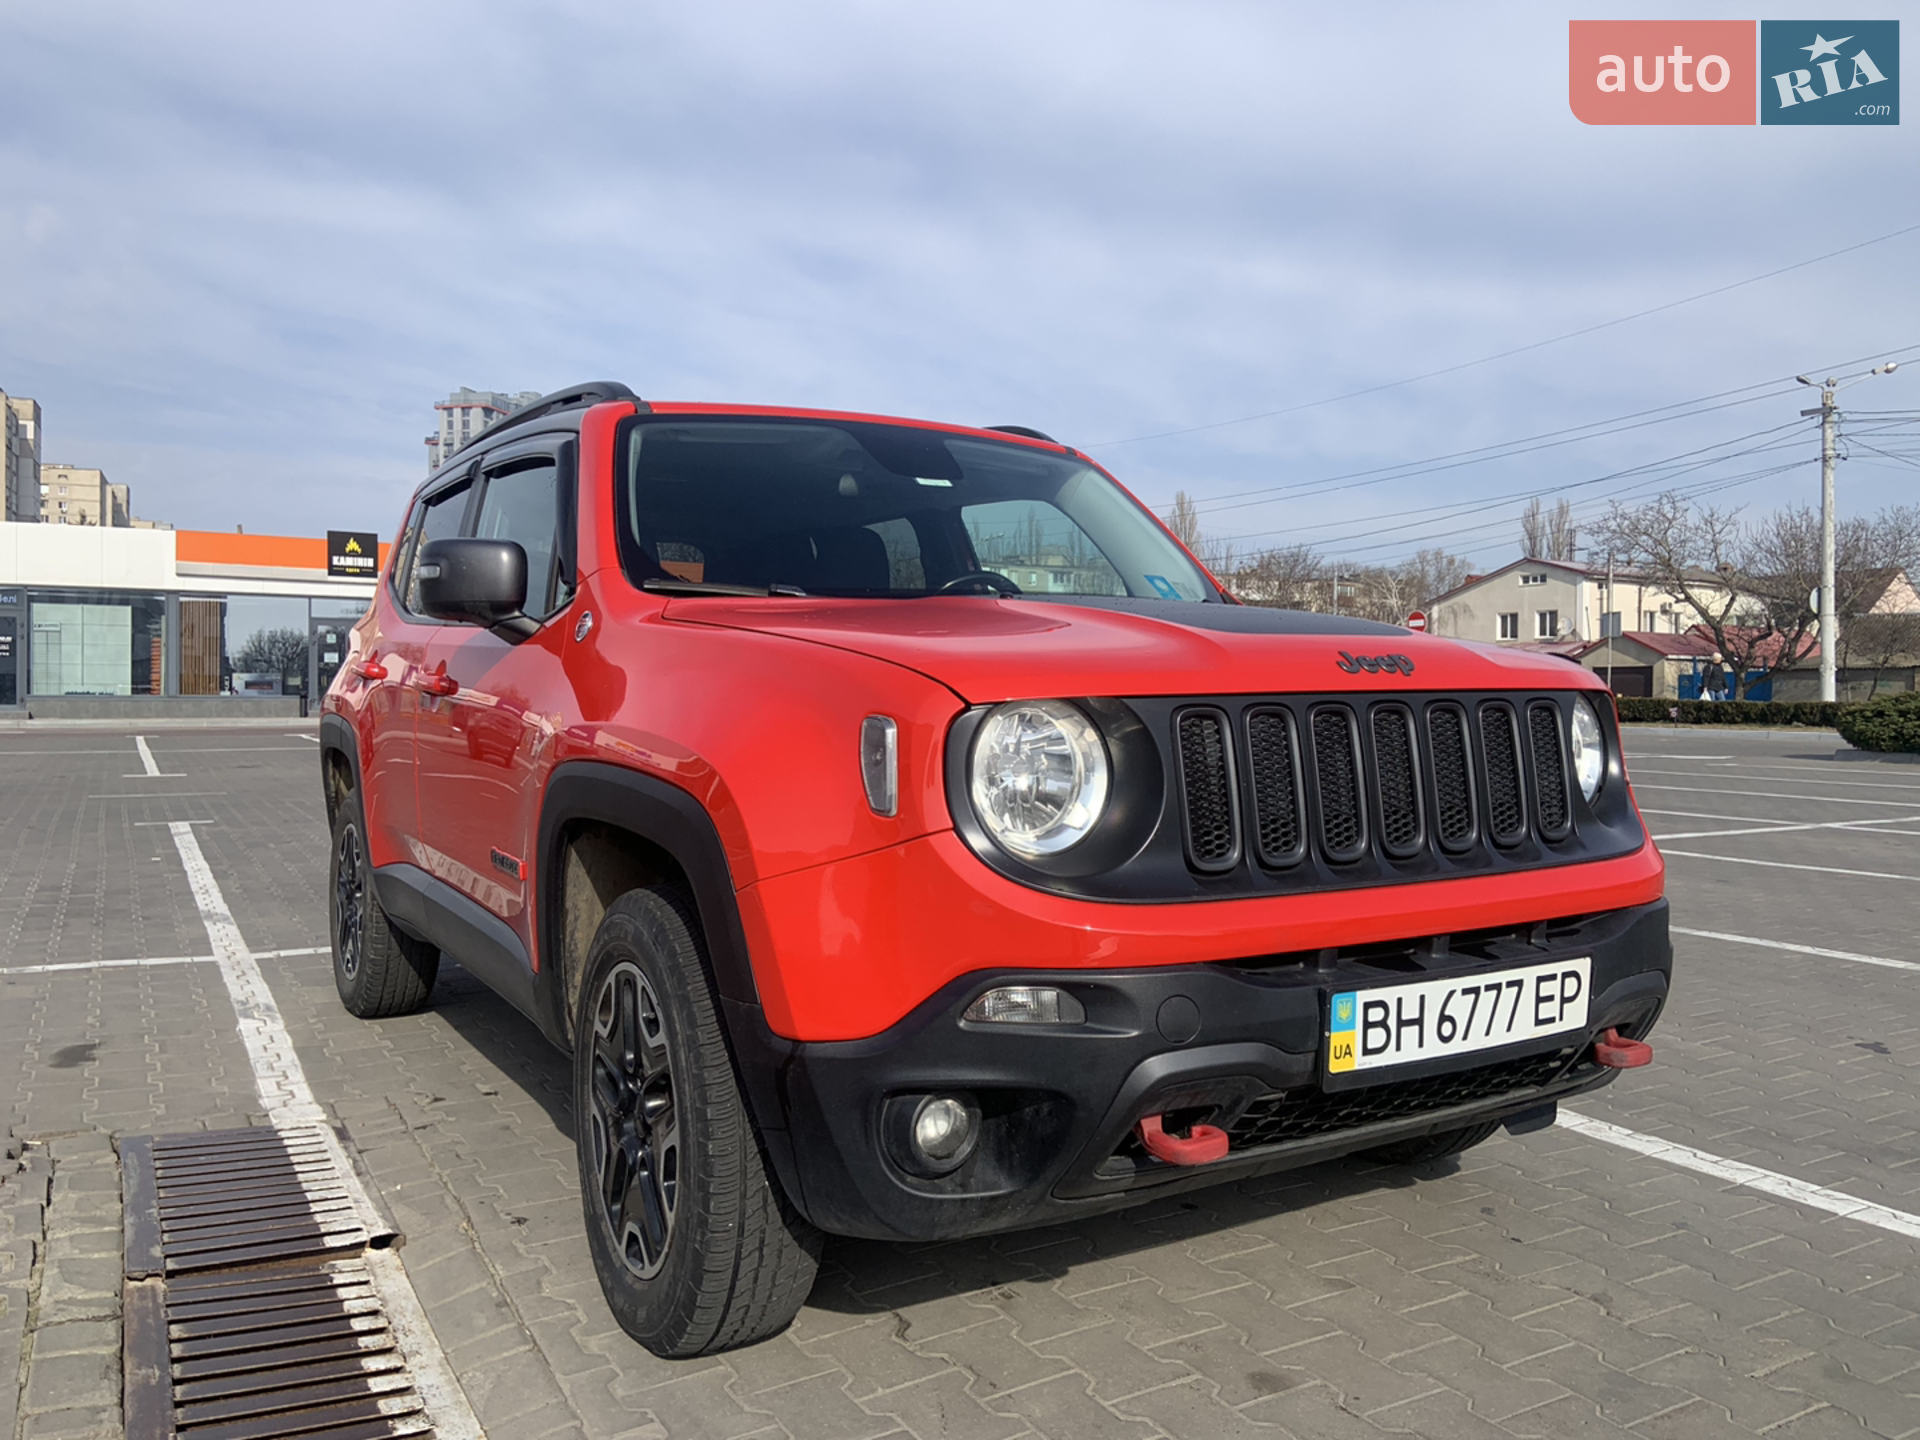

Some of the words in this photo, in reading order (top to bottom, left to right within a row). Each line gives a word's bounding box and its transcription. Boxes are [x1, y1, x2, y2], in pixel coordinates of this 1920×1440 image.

[1336, 650, 1415, 677] Jeep
[1361, 994, 1426, 1057] BH
[1436, 979, 1524, 1045] 6777
[1534, 969, 1582, 1027] EP
[1333, 1043, 1353, 1060] UA
